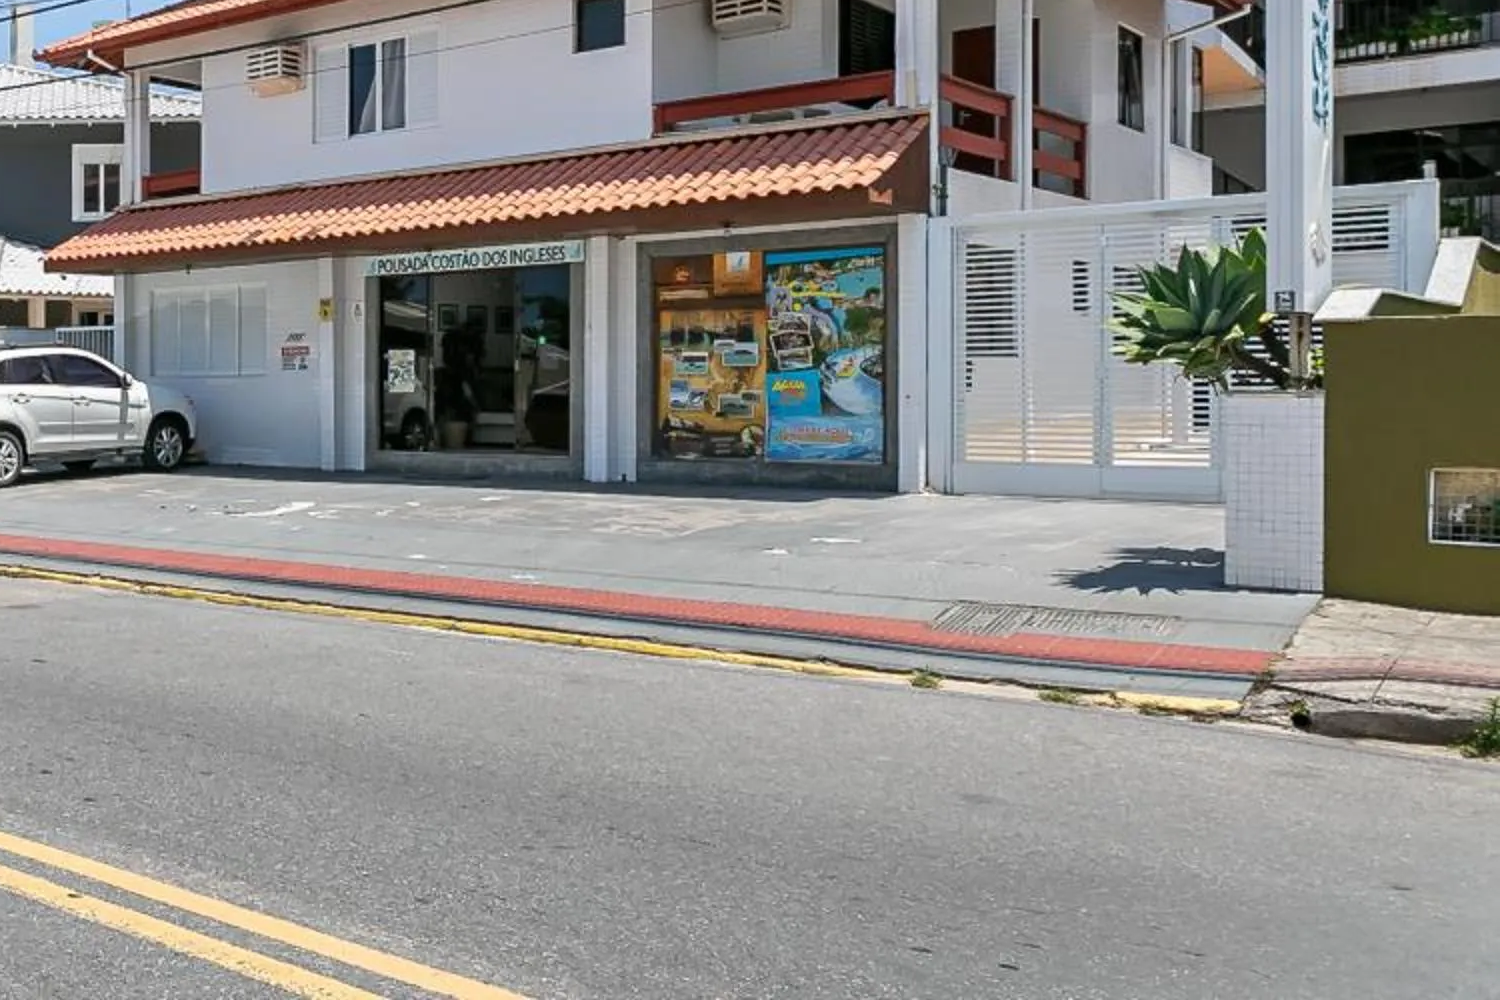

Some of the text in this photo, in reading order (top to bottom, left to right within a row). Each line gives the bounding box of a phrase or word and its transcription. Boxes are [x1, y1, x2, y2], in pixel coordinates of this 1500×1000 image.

[378, 246, 566, 273] POUSADA COSTÃO DOS INGLESES
